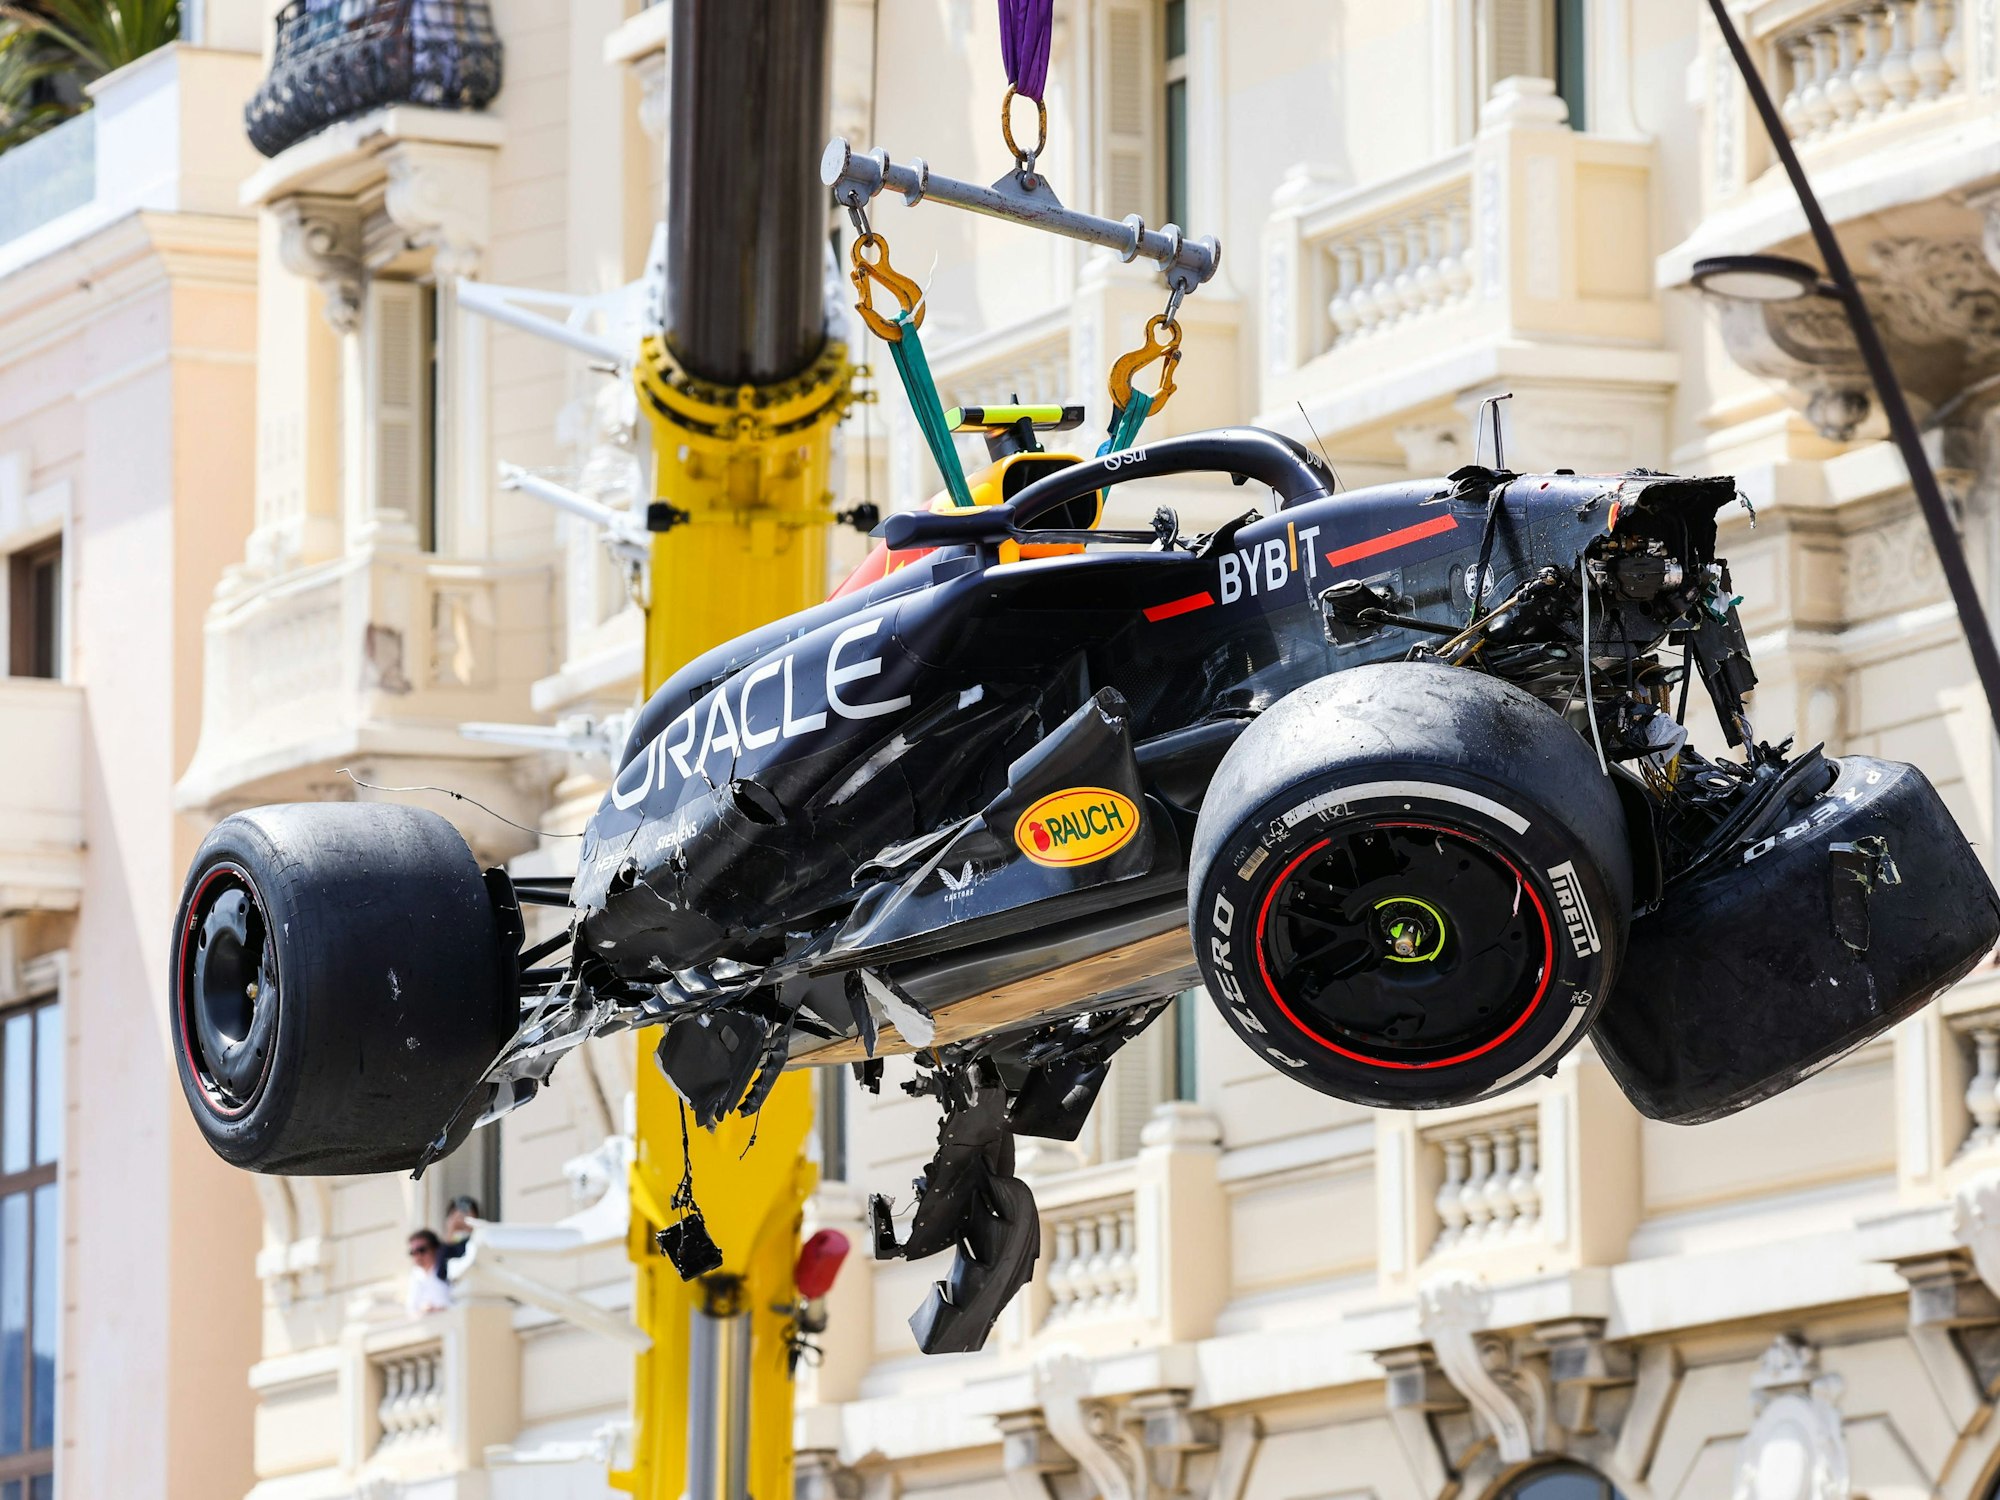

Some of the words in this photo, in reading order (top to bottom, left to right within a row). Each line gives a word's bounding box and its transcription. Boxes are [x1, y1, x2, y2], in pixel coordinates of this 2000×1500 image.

[1219, 521, 1320, 605] BYBIT
[611, 617, 911, 811] ORACLE
[1045, 800, 1125, 847] RAUCH
[1743, 787, 1864, 864] ZERO
[943, 888, 975, 903] CASTORE
[1546, 860, 1602, 959] PIRELLI
[1211, 892, 1268, 1034] ZERO
